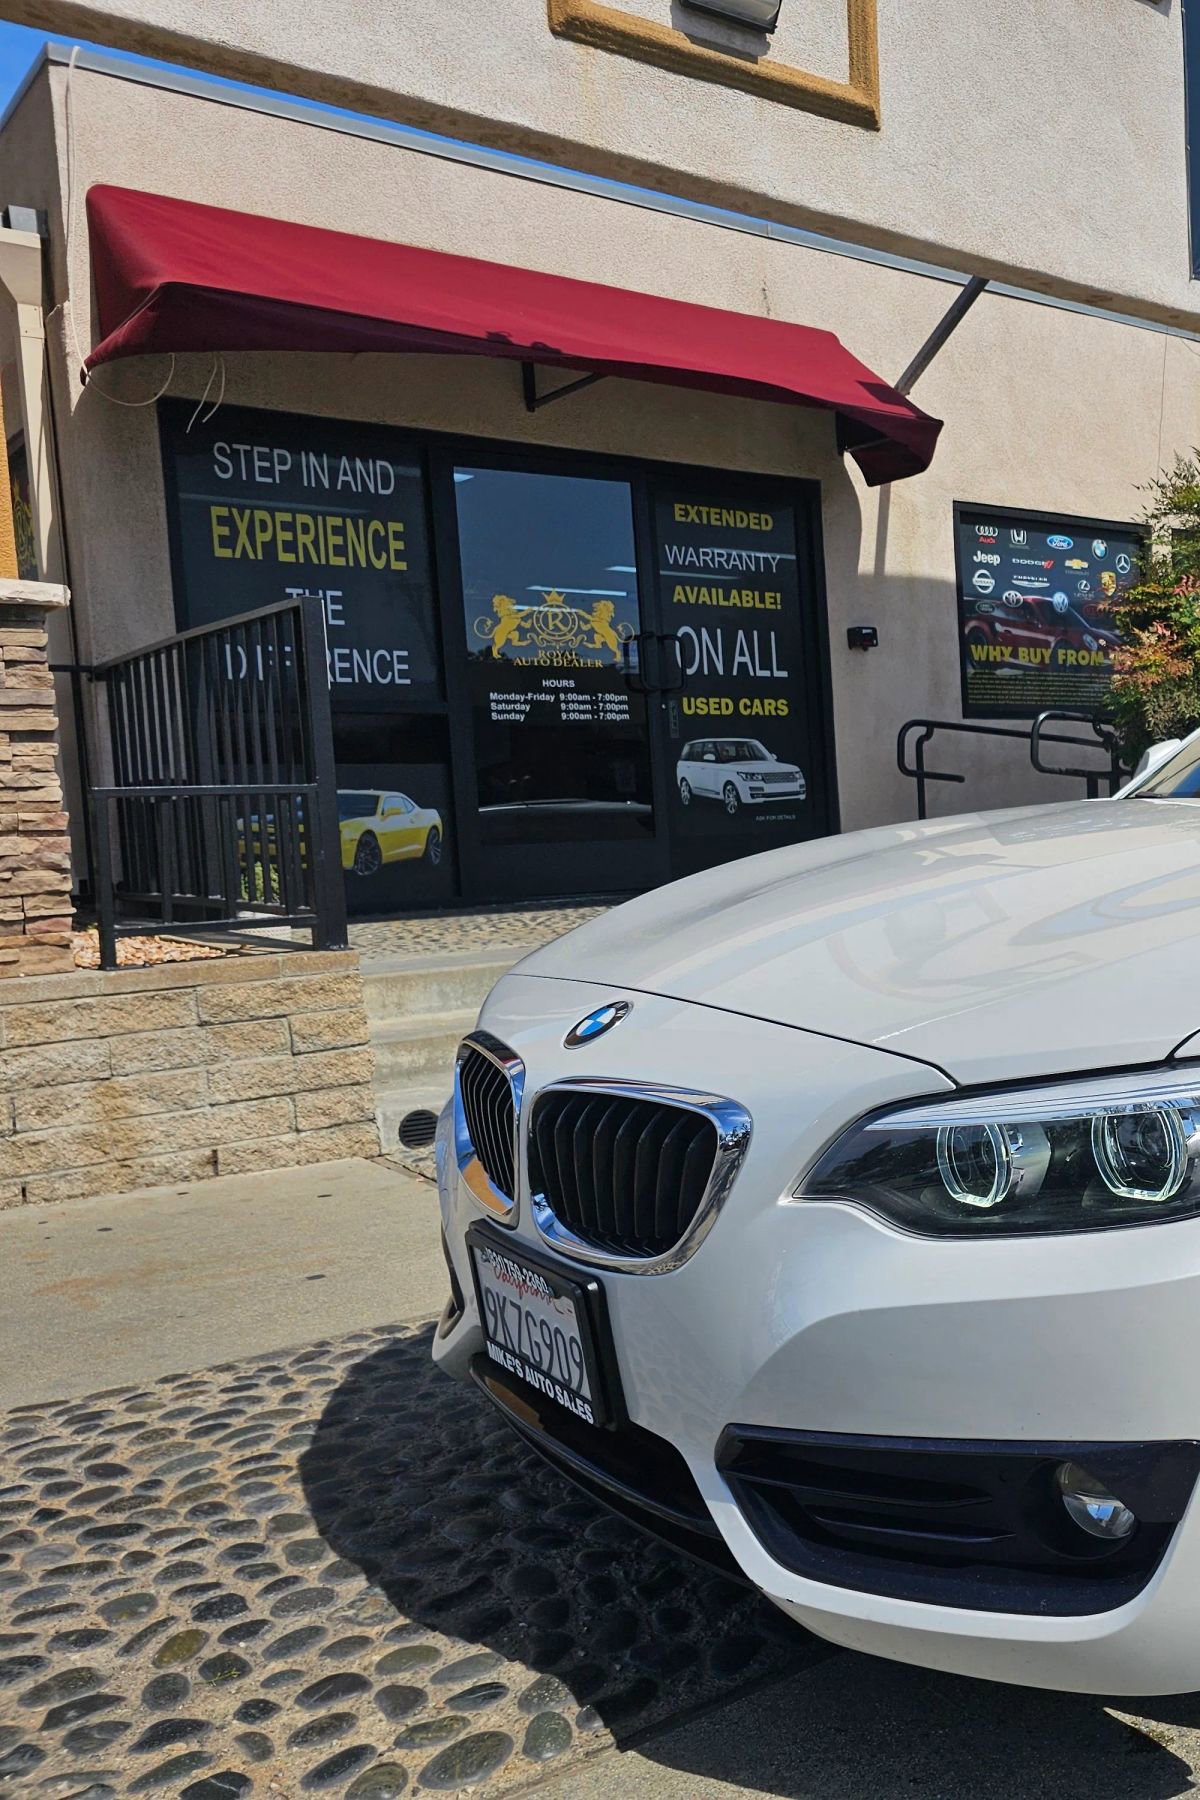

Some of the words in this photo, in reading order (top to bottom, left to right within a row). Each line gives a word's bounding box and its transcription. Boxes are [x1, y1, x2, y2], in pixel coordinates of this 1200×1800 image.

[213, 442, 292, 484] STEP
[301, 450, 330, 489] IN
[337, 455, 395, 495] AND
[673, 503, 774, 532] EXTENDED
[210, 505, 408, 571] EXPERIENCE
[665, 544, 780, 573] WARRANTY
[973, 550, 1000, 566] Jeep
[672, 585, 782, 610] AVAILABLE!
[513, 656, 551, 667] AUTO
[553, 657, 604, 668] DEALER
[538, 650, 578, 660] ROYAL
[676, 625, 725, 677] ON
[732, 627, 788, 678] ALL
[970, 644, 1014, 662] WHY
[1018, 647, 1052, 665] BUY
[1057, 649, 1104, 666] FROM
[542, 679, 575, 688] HOURS
[489, 692, 555, 703] Monday-Friday
[559, 693, 591, 702] 9:00am
[597, 693, 628, 704] 7:00pm
[490, 702, 531, 712] Saturday
[560, 703, 592, 711] 9:00am
[598, 703, 629, 713] 7:00pm
[682, 696, 735, 716] USED
[738, 697, 789, 717] CARS
[491, 712, 525, 722] Sunday
[561, 712, 592, 720] 9:00am
[599, 712, 630, 722] 7:00pm
[486, 1340, 524, 1378] MIKE'S
[525, 1364, 554, 1398] AUTO
[554, 1386, 594, 1425] SALES
